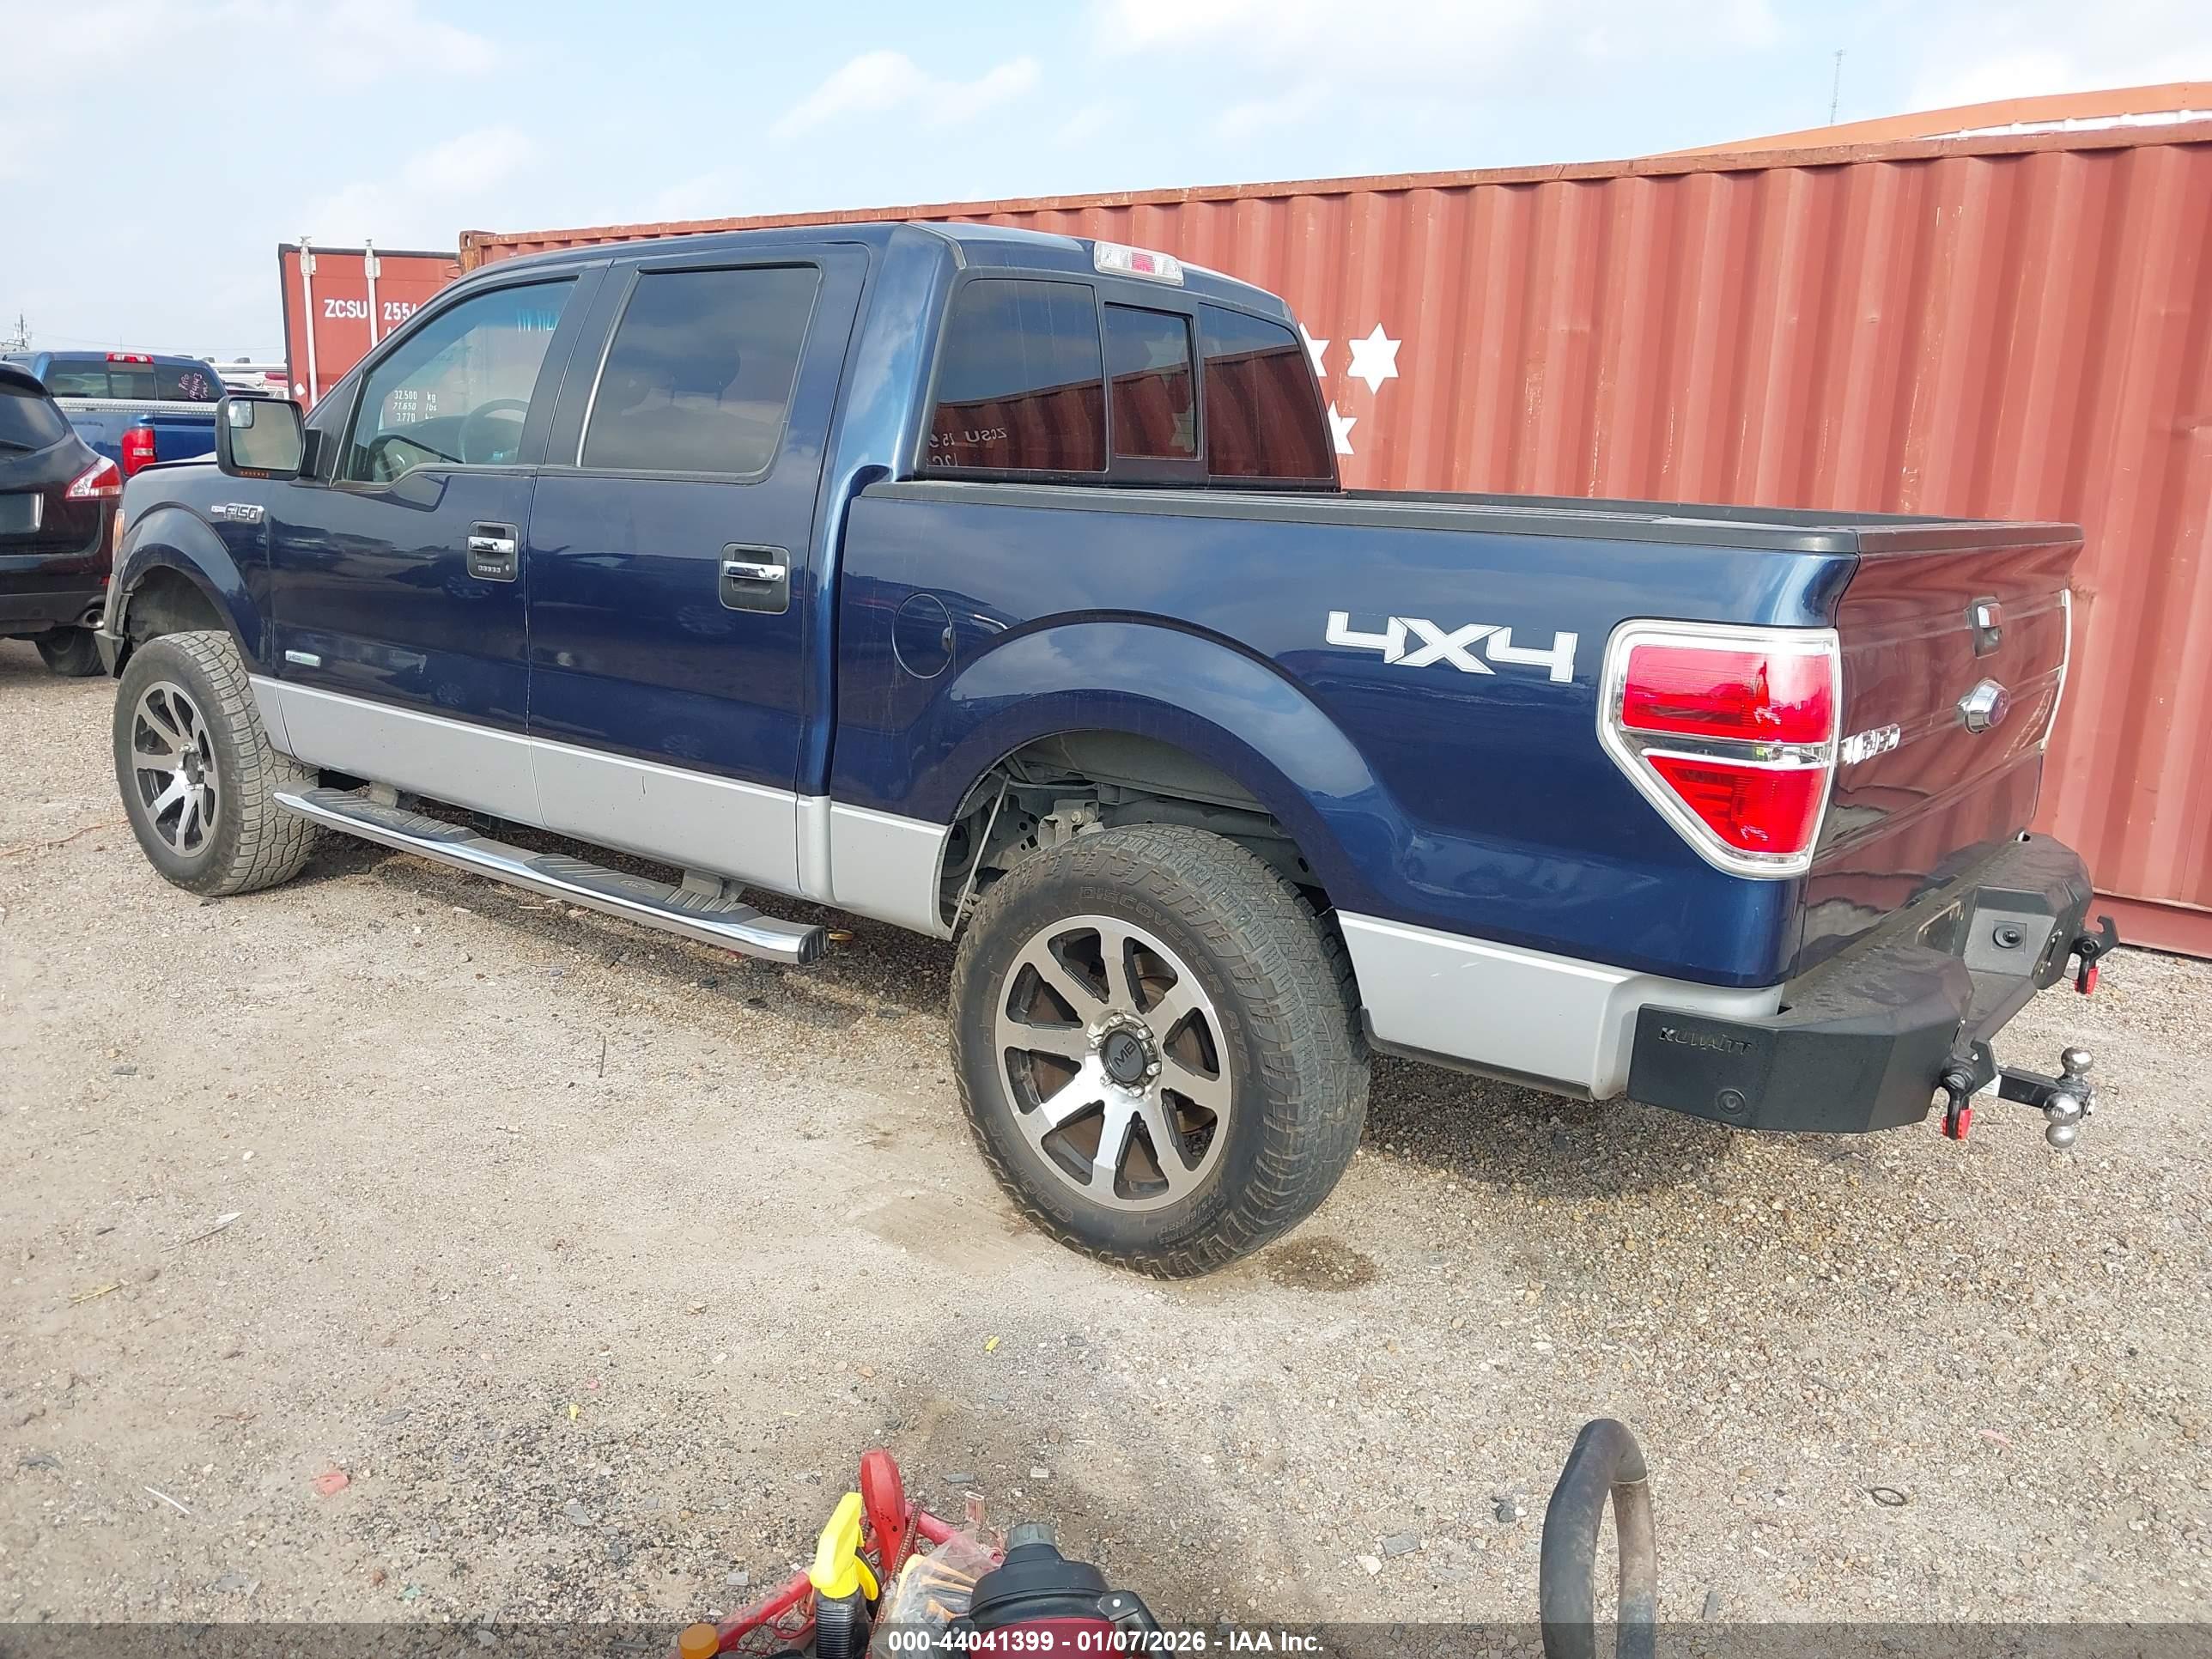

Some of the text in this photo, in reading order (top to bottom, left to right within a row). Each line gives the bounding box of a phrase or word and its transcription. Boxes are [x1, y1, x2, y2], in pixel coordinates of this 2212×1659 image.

[324, 299, 368, 319] ZCSU
[427, 392, 436, 404] kg
[1080, 885, 1225, 994] DISCOVERER
[1113, 1040, 1137, 1067] MB
